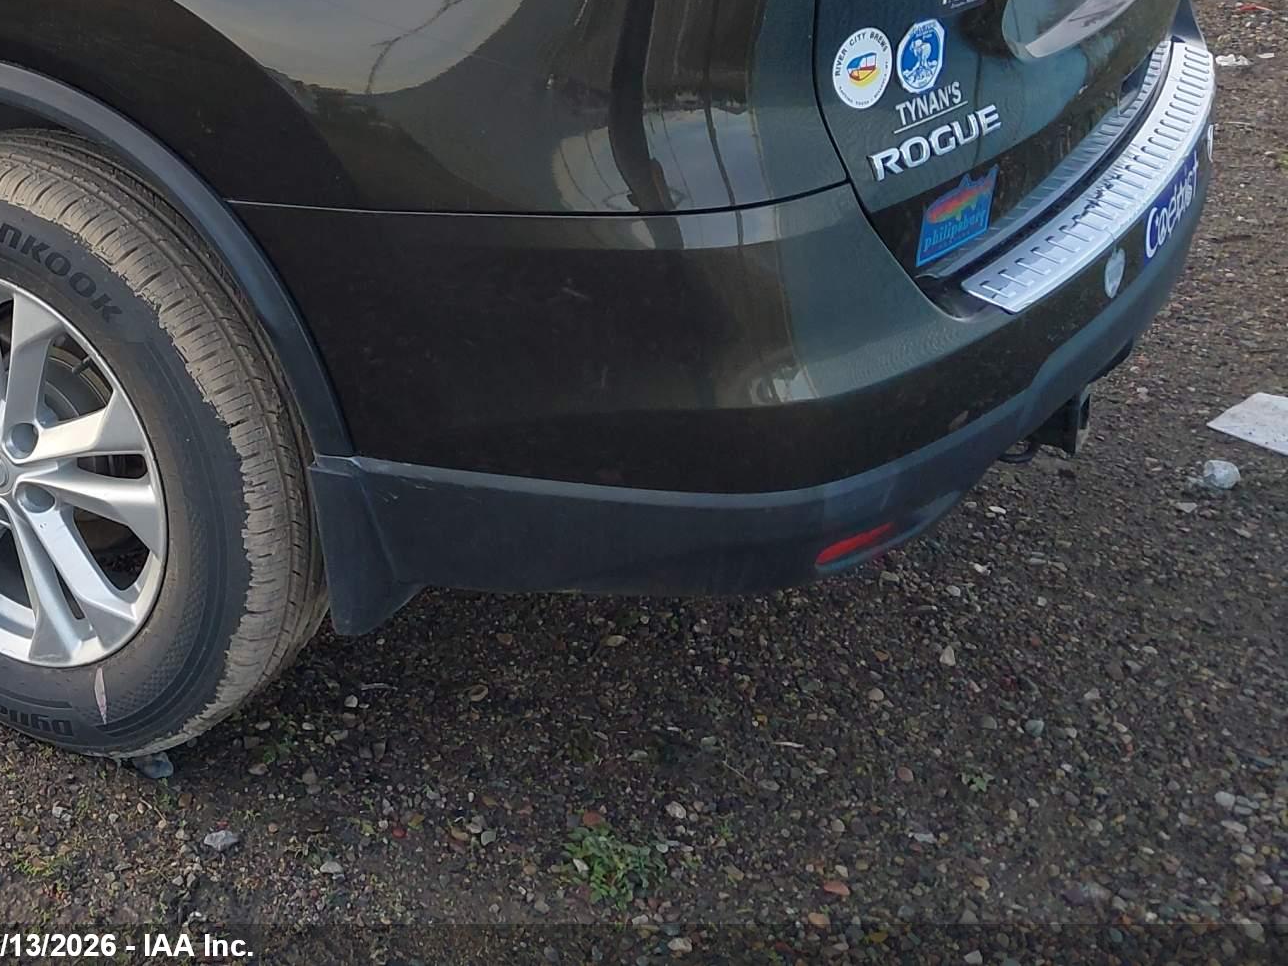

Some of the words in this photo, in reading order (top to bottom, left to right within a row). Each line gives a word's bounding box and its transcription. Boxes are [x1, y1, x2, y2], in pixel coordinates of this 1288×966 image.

[834, 48, 848, 76] RIVER
[849, 31, 867, 47] CITY
[869, 31, 889, 52] BREWS
[895, 81, 962, 126] TYNAN'S
[868, 104, 1002, 182] ROGUE
